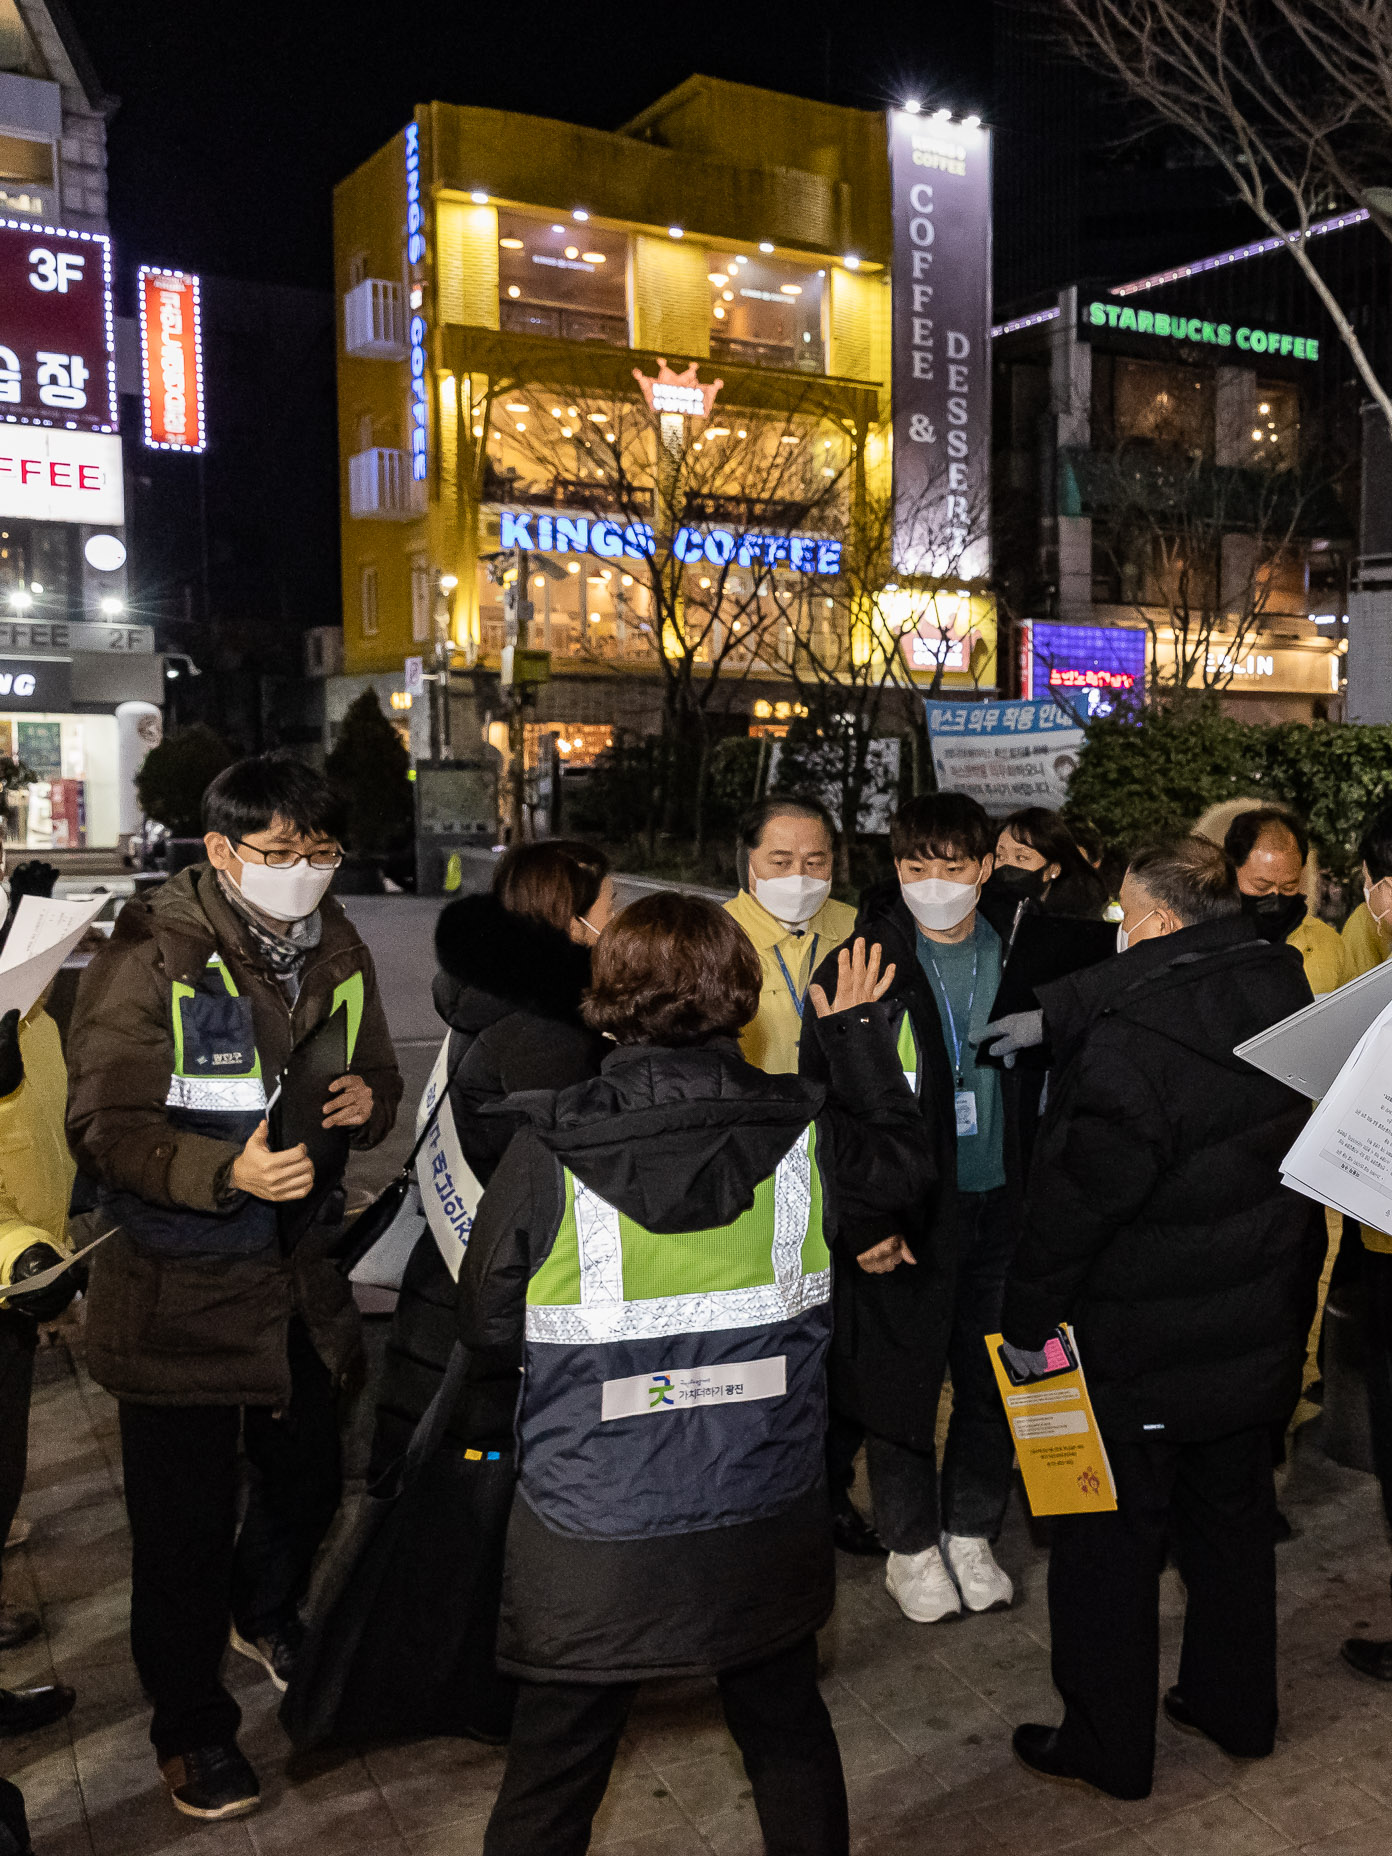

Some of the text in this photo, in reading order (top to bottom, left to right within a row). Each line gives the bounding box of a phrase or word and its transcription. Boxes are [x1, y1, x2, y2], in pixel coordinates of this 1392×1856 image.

[28, 248, 85, 293] 3F
[909, 183, 936, 443] COFFEE &
[1089, 302, 1319, 361] STARBUCKS COFFEE
[500, 511, 842, 575] KINGS COFFEE
[679, 1384, 744, 1400] 가치더하기 광진
